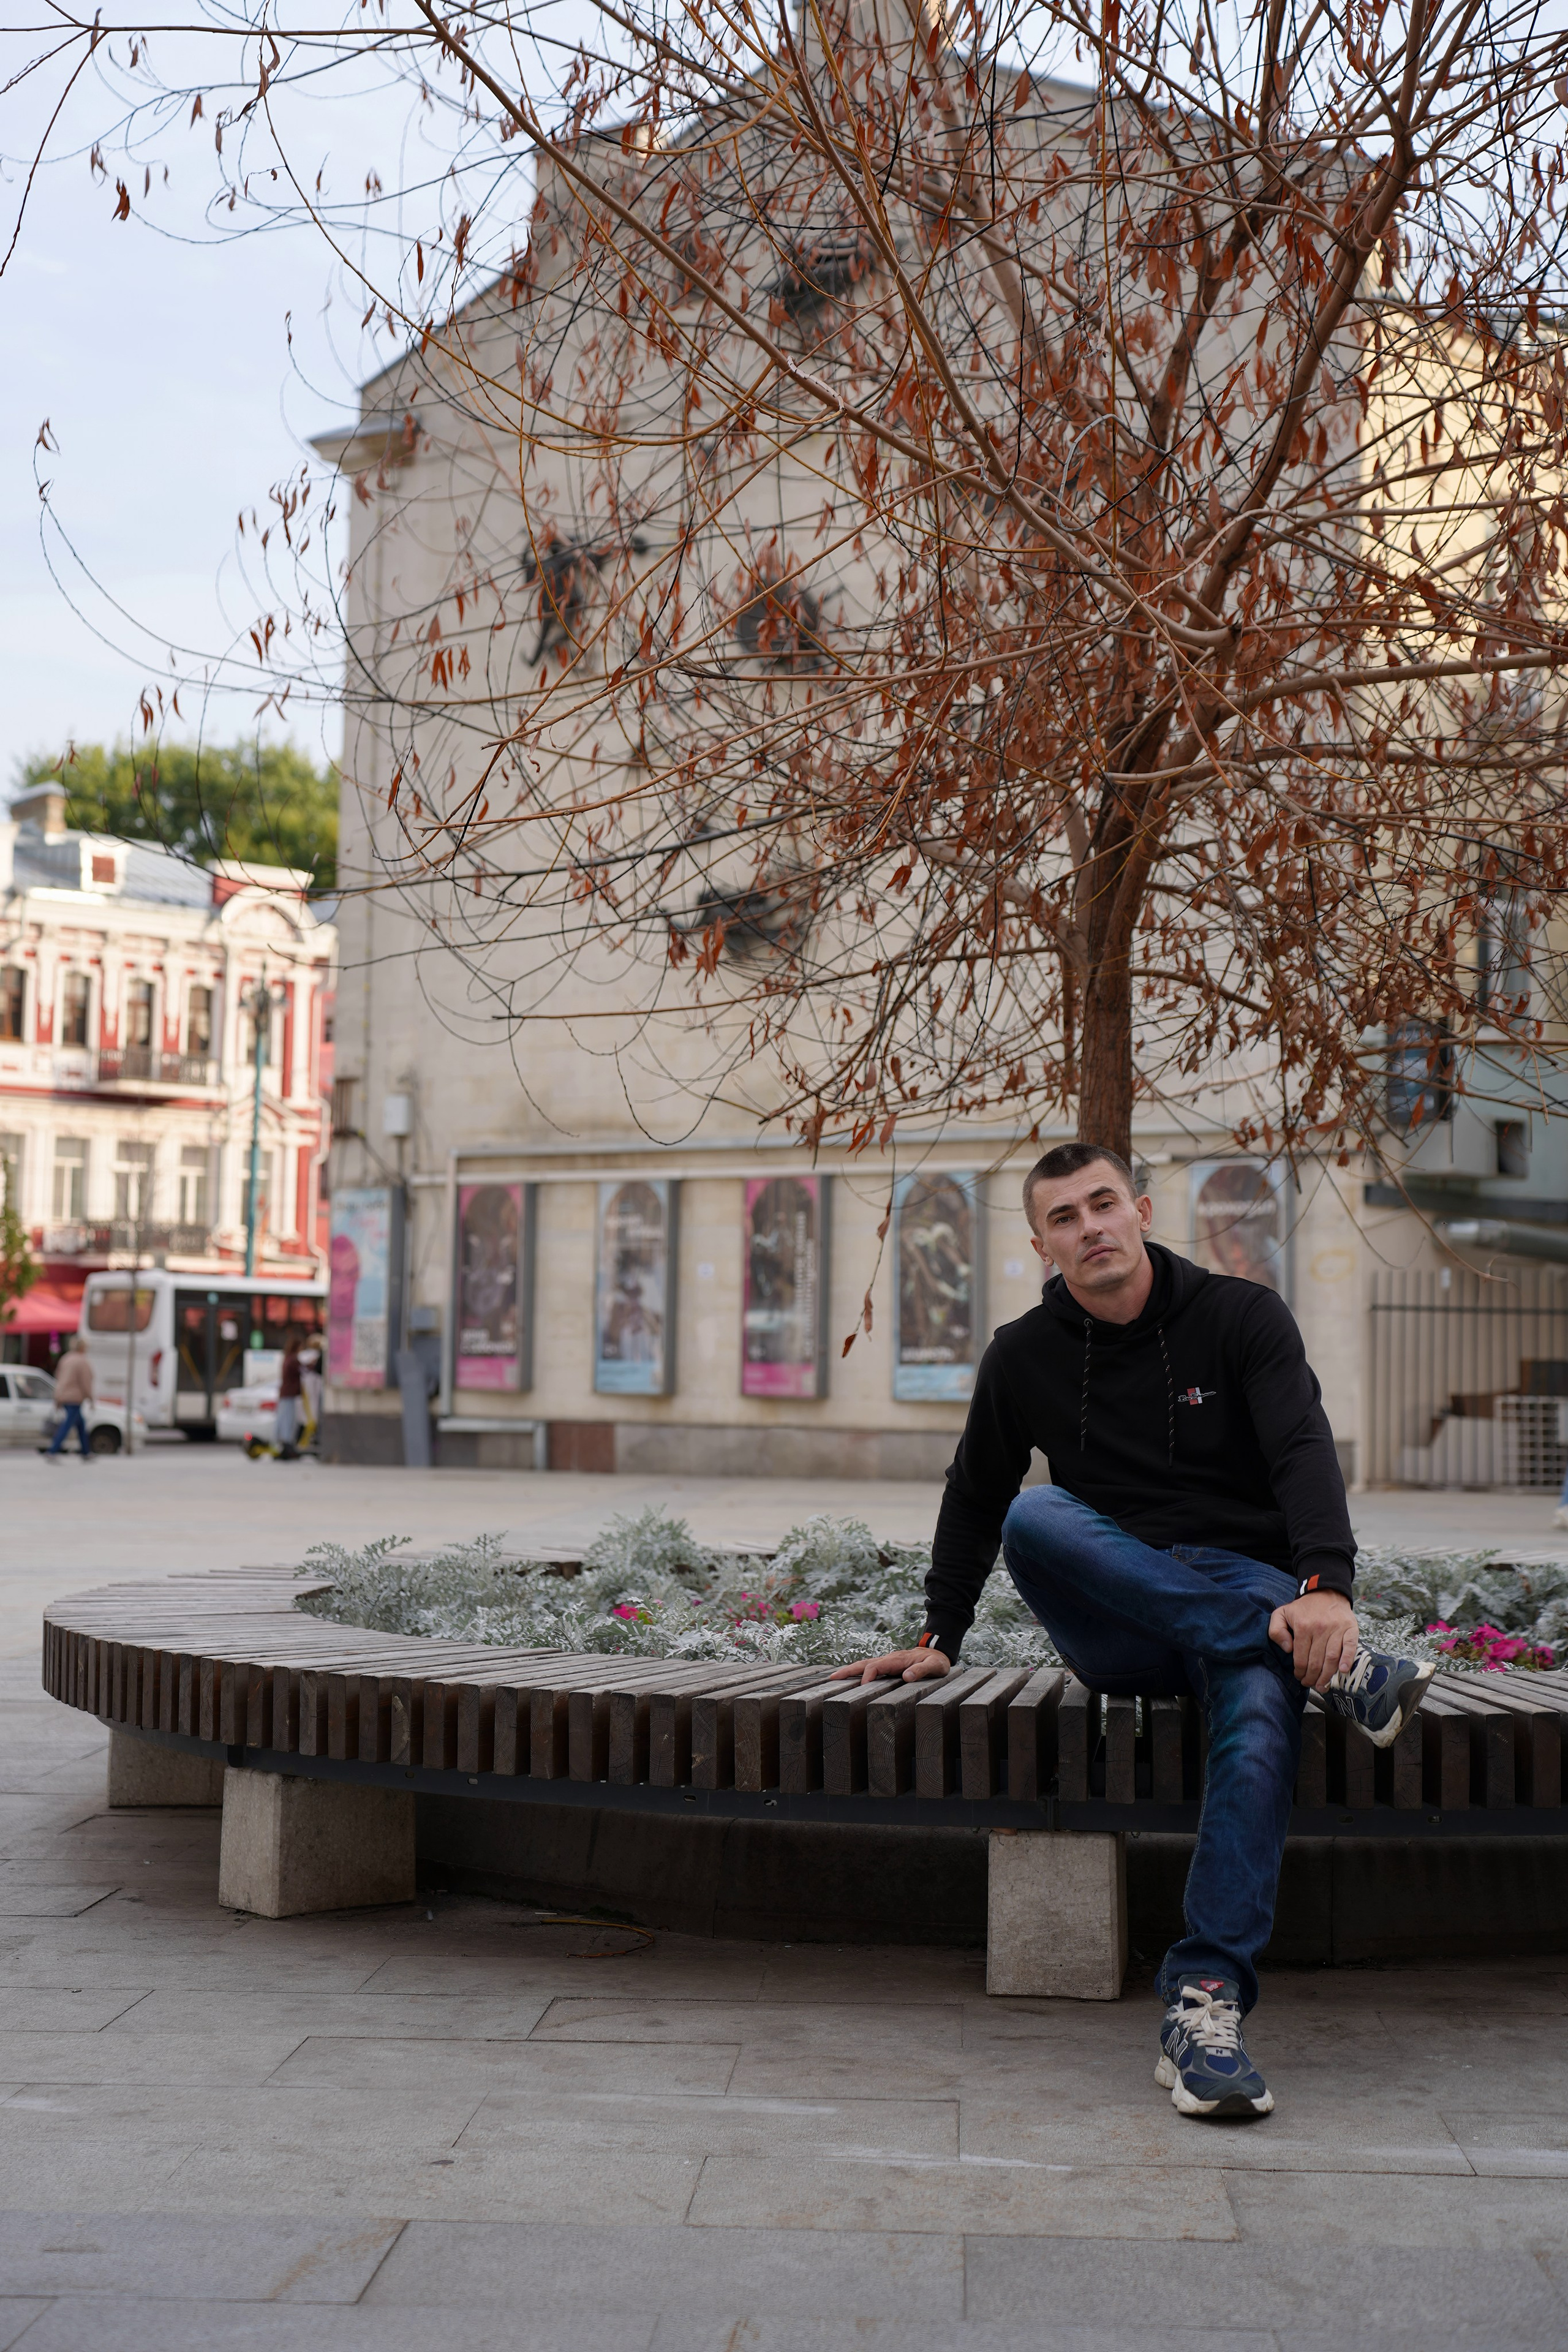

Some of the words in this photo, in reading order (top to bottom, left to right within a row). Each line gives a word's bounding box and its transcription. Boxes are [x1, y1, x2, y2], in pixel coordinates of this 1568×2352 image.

[1364, 1672, 1370, 1680] N
[1333, 1693, 1358, 1722] N
[1165, 2026, 1188, 2068] N
